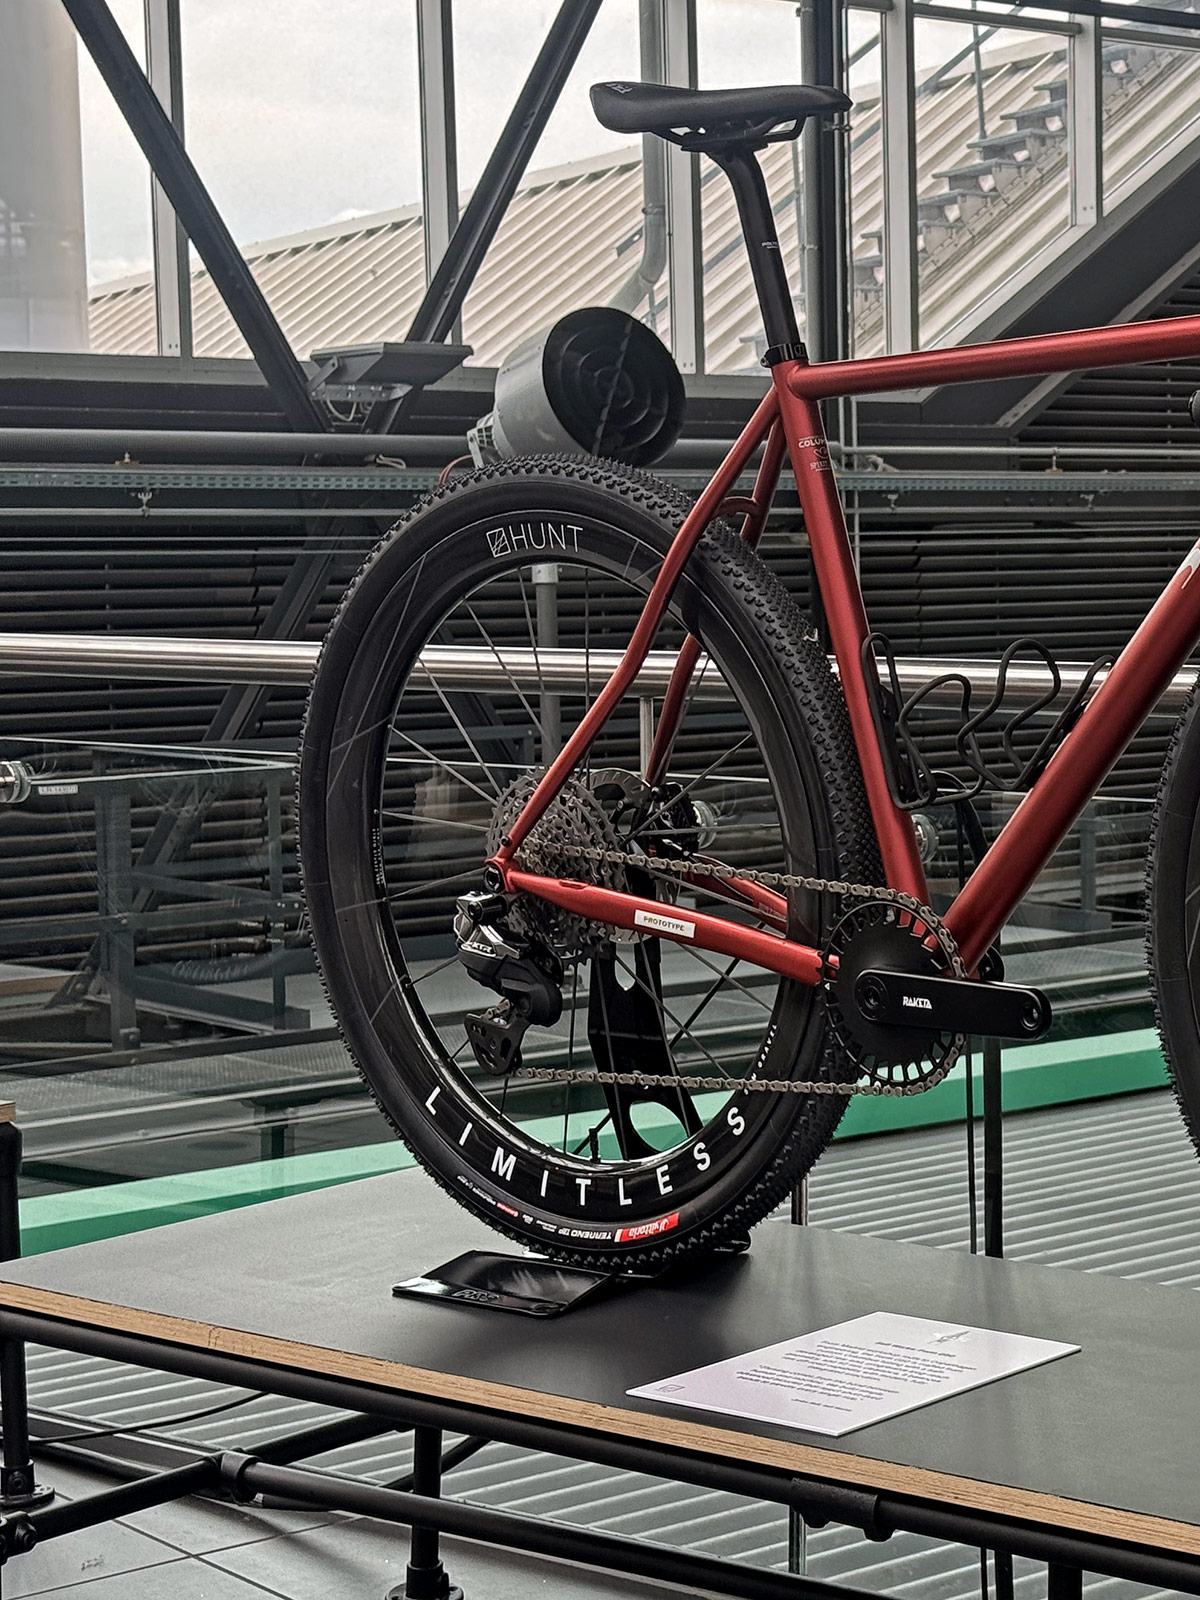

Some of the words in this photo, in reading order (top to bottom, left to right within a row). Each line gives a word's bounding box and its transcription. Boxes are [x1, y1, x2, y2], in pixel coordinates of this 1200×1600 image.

[508, 522, 583, 552] HUNT
[643, 915, 686, 932] PROTOTYPE
[902, 996, 933, 1010] RAKETA
[425, 1086, 746, 1206] LIMITLESS
[570, 1229, 612, 1240] TERRENO
